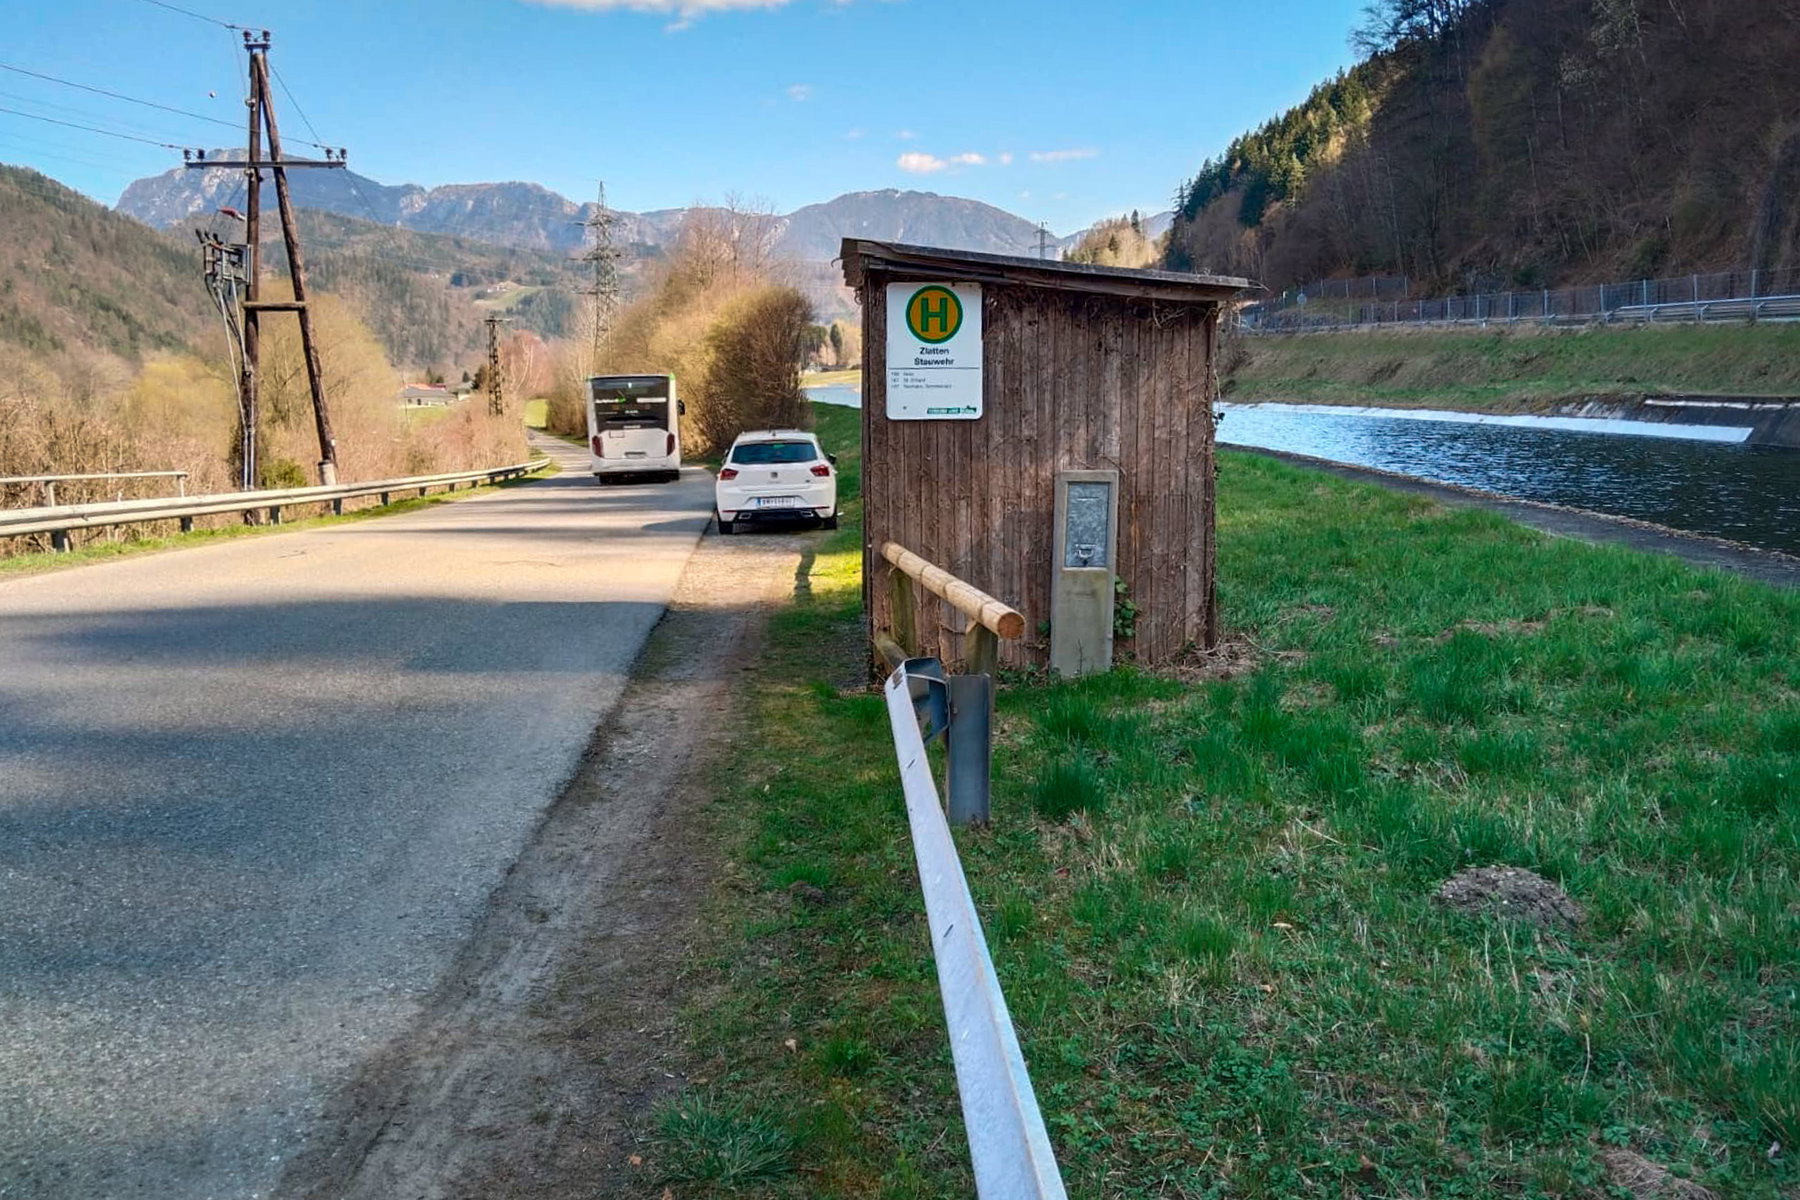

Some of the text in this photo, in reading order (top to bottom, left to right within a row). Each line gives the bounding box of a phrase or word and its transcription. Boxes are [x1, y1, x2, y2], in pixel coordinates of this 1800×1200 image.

[921, 297, 947, 332] H
[919, 347, 950, 355] Zlatten
[914, 357, 954, 366] Stauwehr
